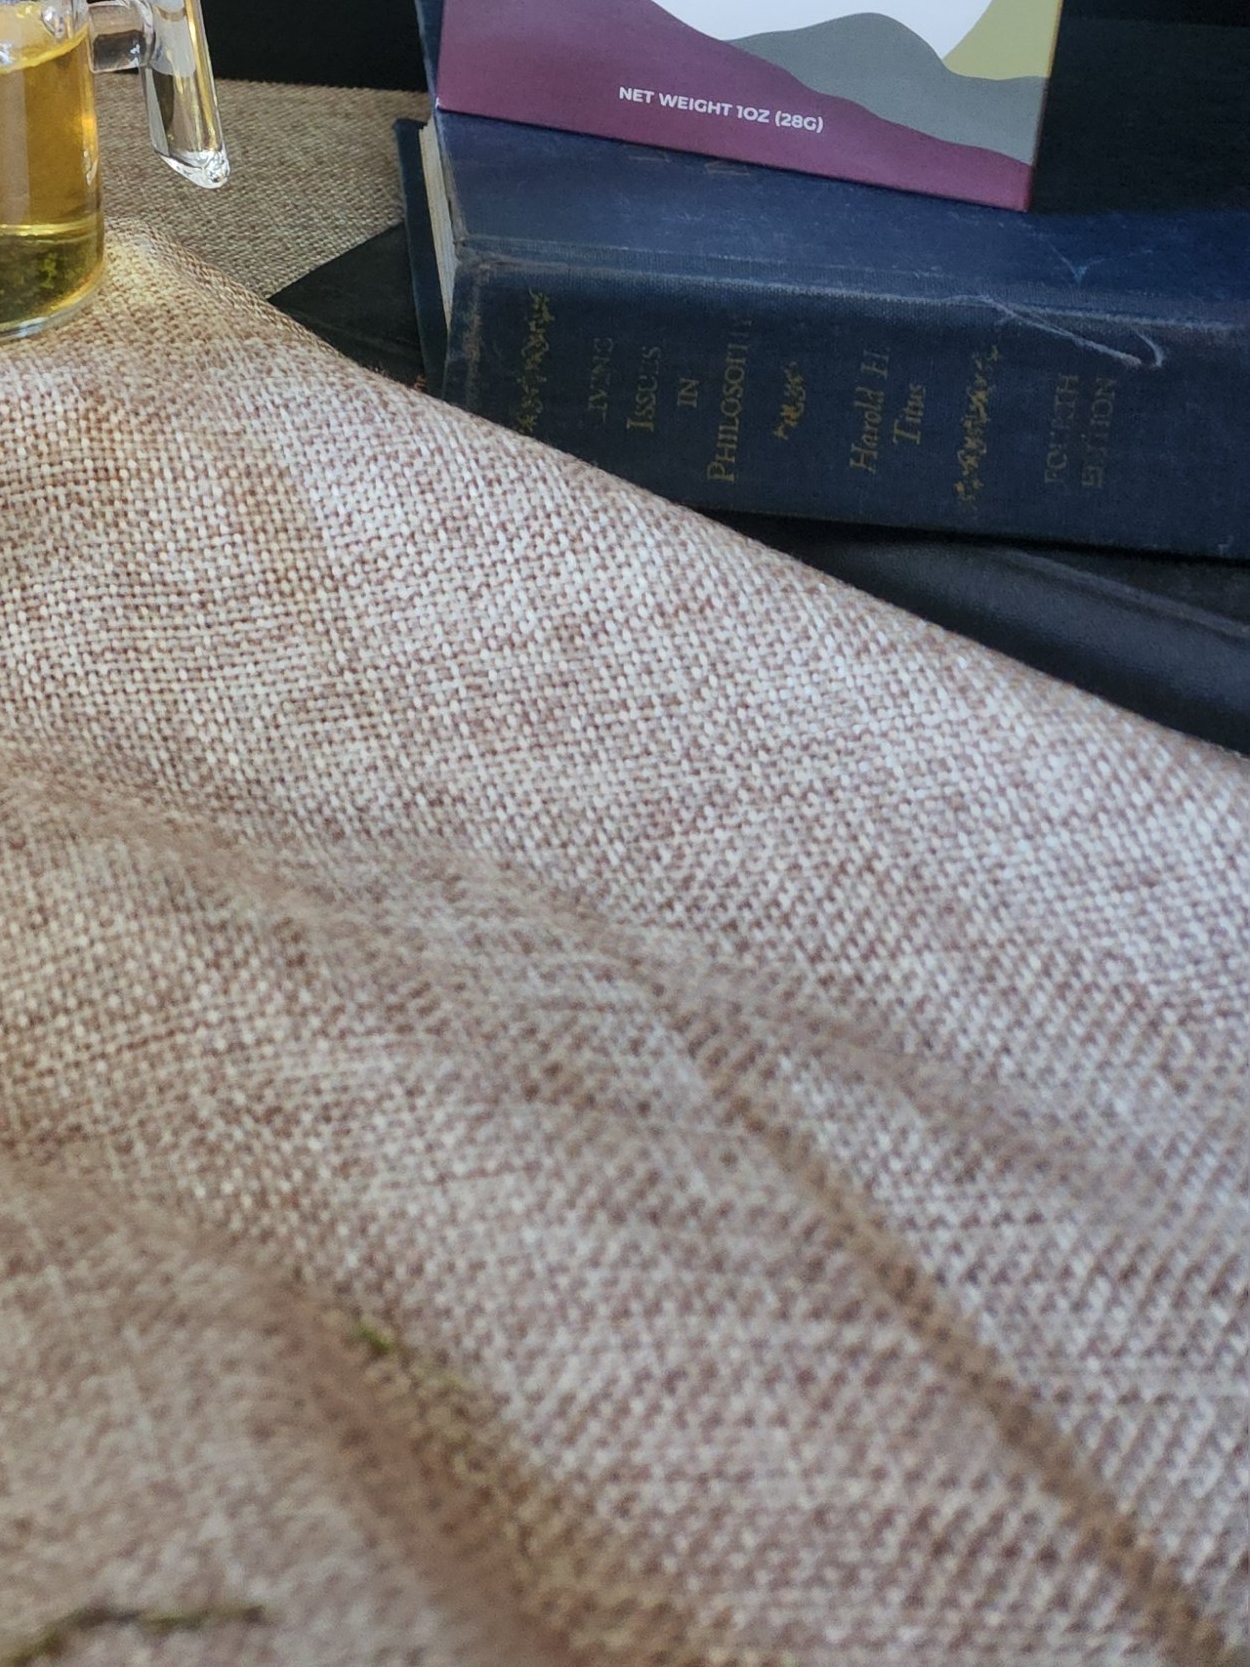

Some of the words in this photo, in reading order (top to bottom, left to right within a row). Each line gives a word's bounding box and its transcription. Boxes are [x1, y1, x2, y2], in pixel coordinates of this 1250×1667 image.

[619, 86, 654, 104] NET
[659, 92, 733, 116] WEIGHT
[774, 110, 824, 133] (28G)
[677, 377, 700, 408] IN
[893, 384, 926, 445] Titus
[850, 385, 885, 474] Harold
